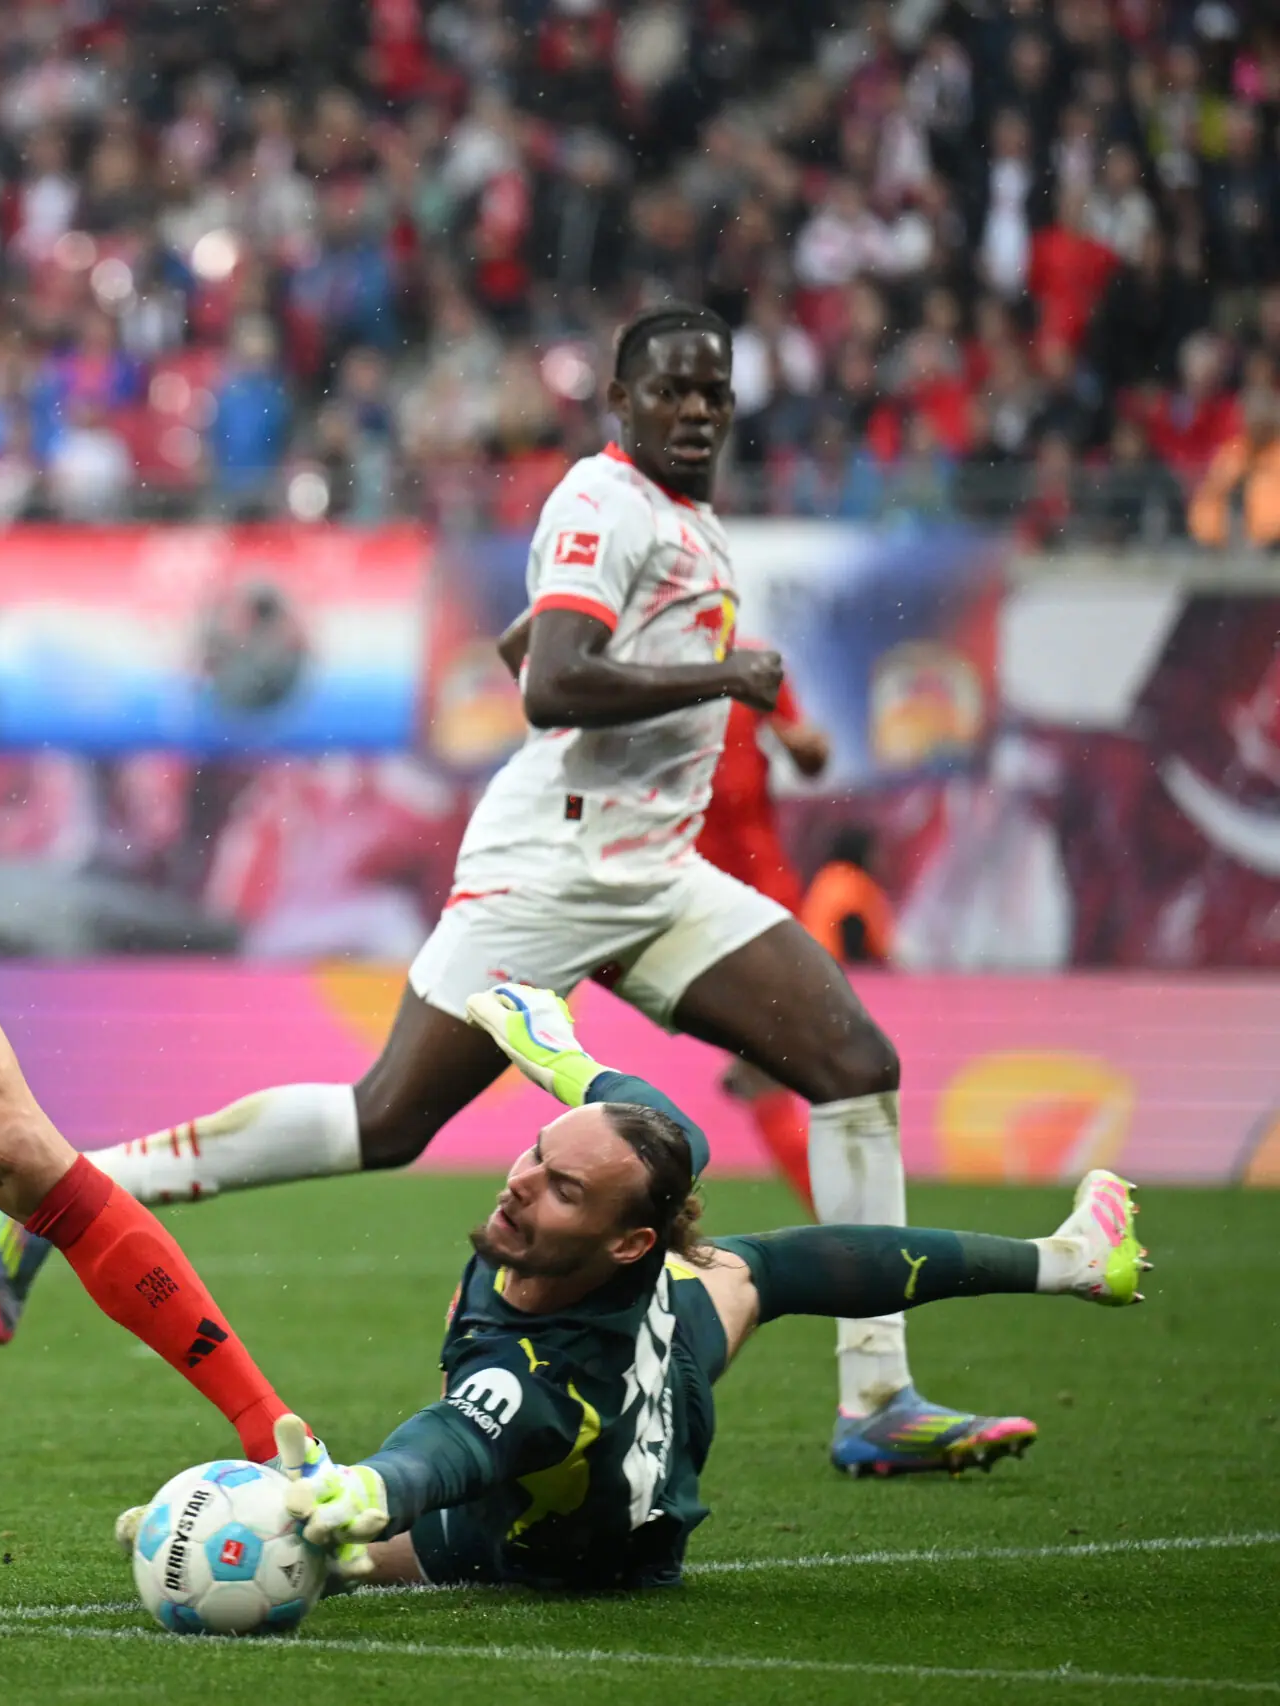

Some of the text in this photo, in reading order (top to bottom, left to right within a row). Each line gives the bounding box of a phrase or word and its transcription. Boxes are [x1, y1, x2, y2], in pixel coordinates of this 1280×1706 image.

[134, 1266, 165, 1294] MIA
[148, 1282, 180, 1309] MIA
[165, 1489, 211, 1592] DERBYSTAR
